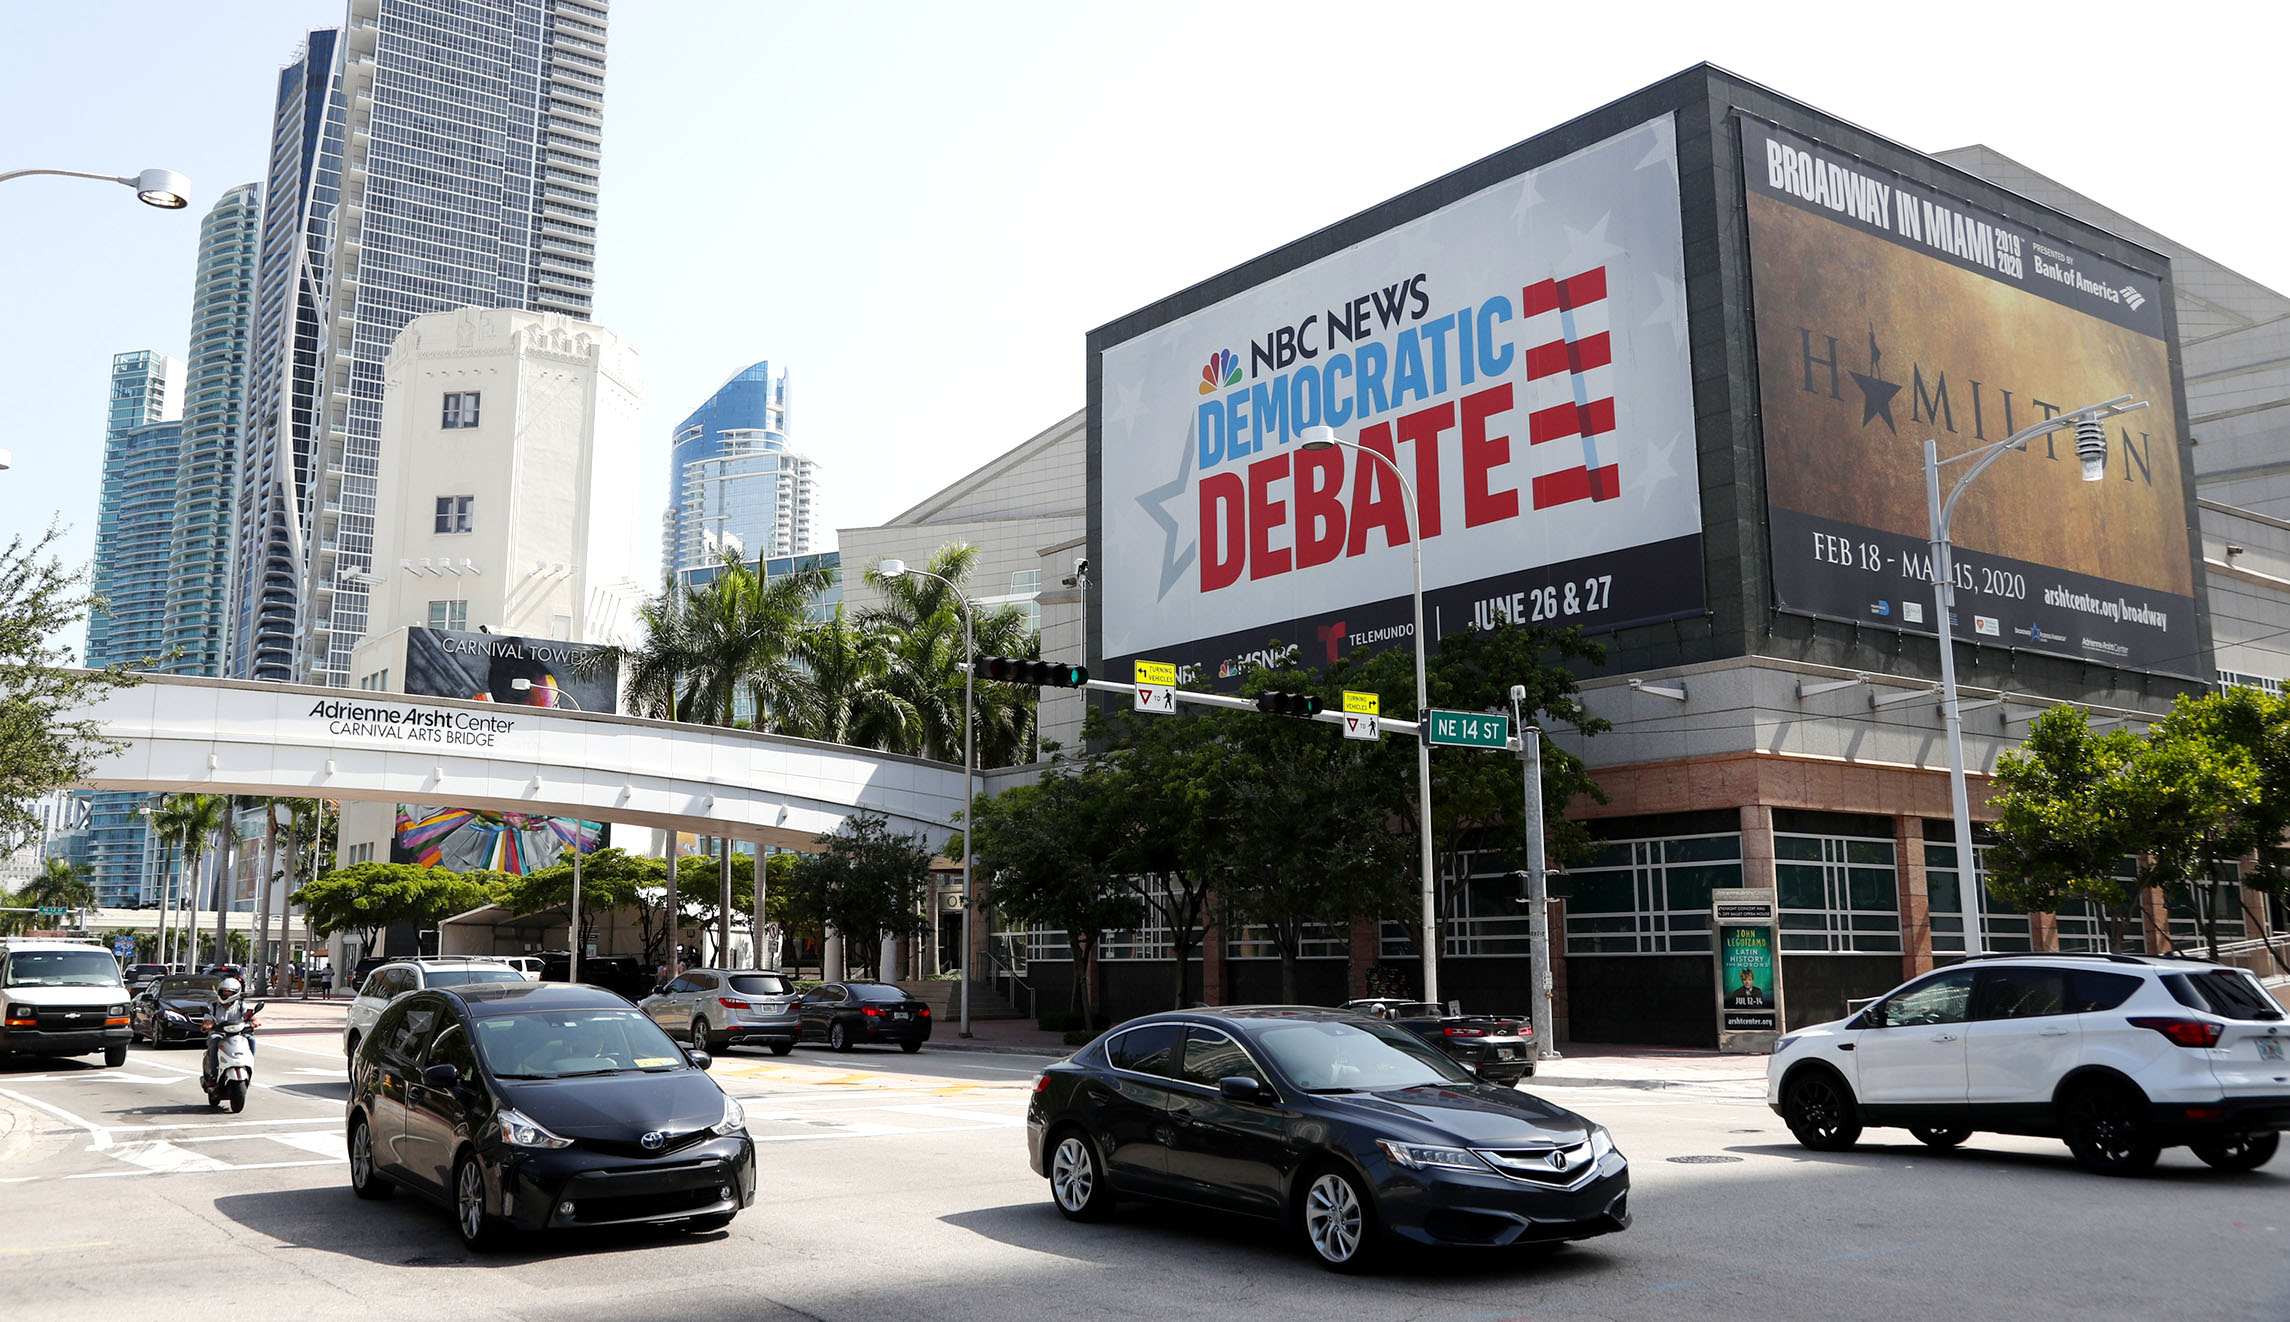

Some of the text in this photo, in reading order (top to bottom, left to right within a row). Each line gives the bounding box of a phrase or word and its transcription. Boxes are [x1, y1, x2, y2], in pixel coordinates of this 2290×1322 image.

[1766, 138, 1996, 269] BROADWAY IN MIAMI
[1995, 228, 2021, 257] 2019
[2032, 243, 2074, 265] PRESENTED BY
[1997, 251, 2023, 279] 2020
[2034, 255, 2120, 303] Bank of America
[1252, 273, 1430, 379] NBC NEWS
[1199, 295, 1514, 470] DEMOCRATIC
[1801, 325, 2153, 487] HMILTN
[1199, 382, 1520, 593] DEBATE
[1813, 532, 1852, 566] FEB
[1859, 542, 1881, 571] 18
[1902, 551, 1937, 582] MA
[1953, 563, 1979, 594] 15,
[1983, 568, 2026, 600] 2020
[1468, 575, 1612, 632] JUNE 26 & 27
[2044, 584, 2167, 632] arshtcenter.org/broadway
[1349, 623, 1415, 647] TELEMUNDO
[442, 637, 524, 660] CARNIVAL
[1148, 674, 1174, 683] VEHICLES
[1149, 665, 1173, 675] TURNING
[1345, 703, 1368, 711] VEHICLES
[1346, 695, 1367, 703] TURNING
[309, 700, 515, 734] Adrienne Arsht Center
[1438, 719, 1500, 740] NE 14 ST
[329, 721, 495, 747] CARNIVAL ARTS BRIDGE
[1727, 937, 1767, 947] LEGUIZAMO
[1736, 929, 1756, 938] JOHN
[1735, 996, 1763, 1006] JUL 12-14
[1727, 1017, 1773, 1027] arshtcenter.org
